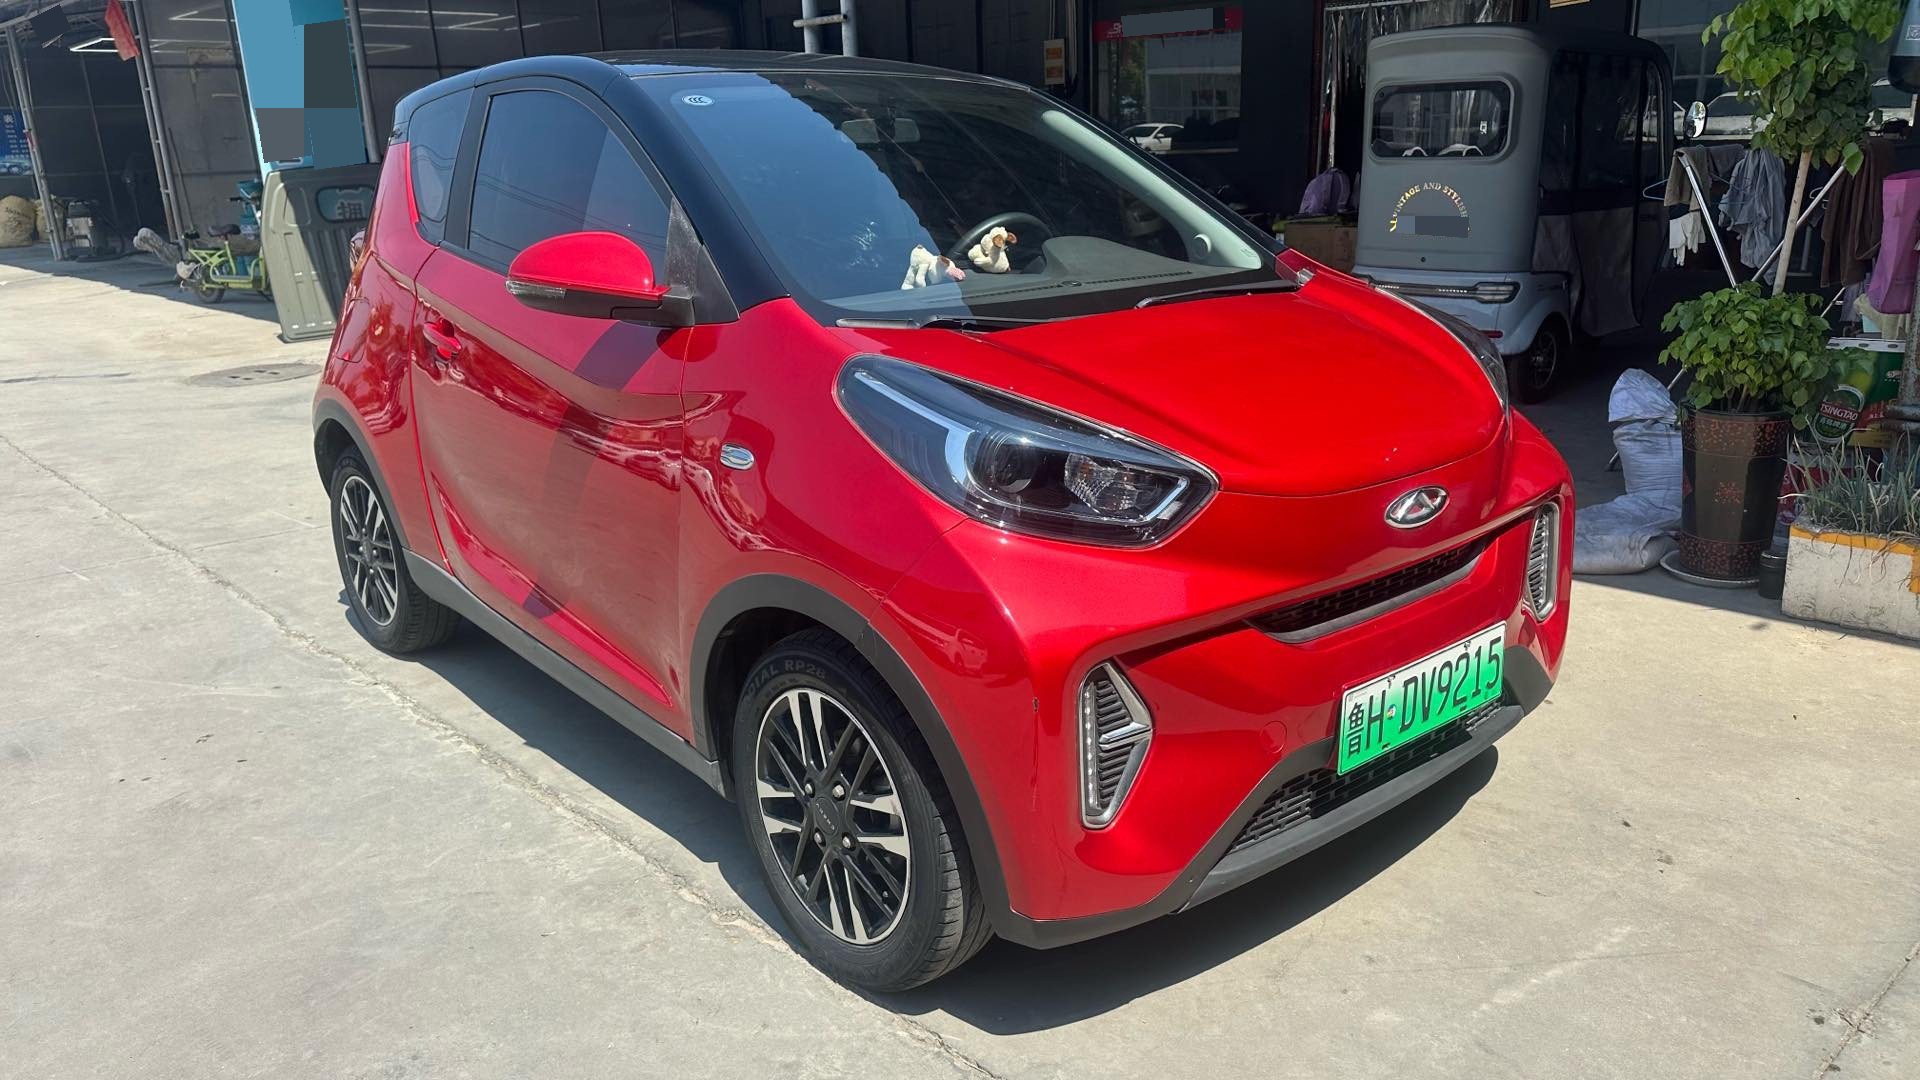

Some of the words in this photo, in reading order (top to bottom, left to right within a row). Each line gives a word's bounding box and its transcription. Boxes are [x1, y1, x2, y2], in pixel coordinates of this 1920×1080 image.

[1392, 184, 1421, 218] VINTAGE
[1423, 182, 1442, 191] AND
[1443, 185, 1468, 218] STYLISH
[1821, 403, 1858, 421] TSINGTAO
